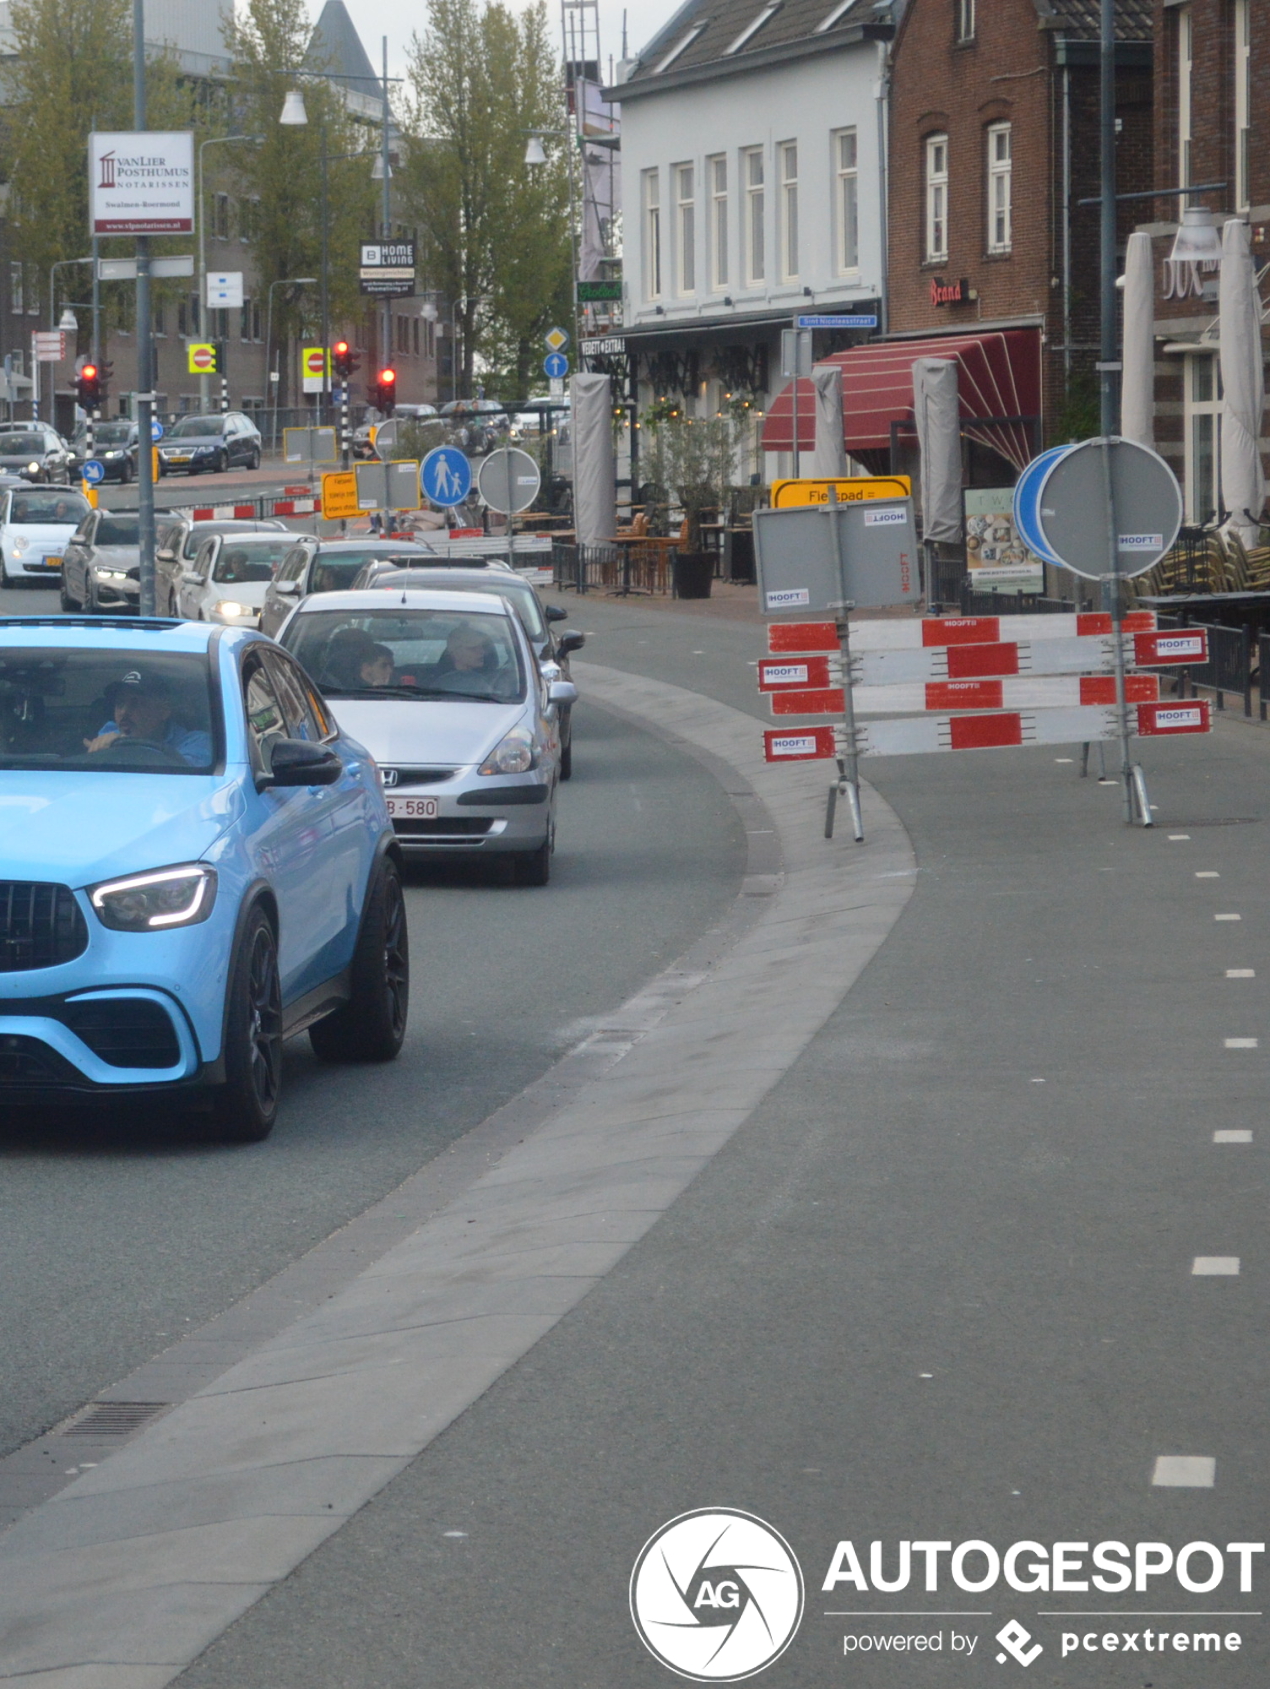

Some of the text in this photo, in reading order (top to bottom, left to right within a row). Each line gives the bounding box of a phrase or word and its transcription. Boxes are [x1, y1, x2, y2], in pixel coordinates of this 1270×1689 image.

[117, 167, 189, 177] POSTHUMUS
[382, 245, 413, 255] HOME
[382, 256, 414, 265] LIVING
[930, 279, 962, 306] Brand
[873, 514, 904, 522] HOOFT
[1121, 536, 1154, 544] HOOFT
[770, 592, 801, 602] HOOFT
[1159, 640, 1191, 648] HOOFT
[767, 668, 799, 676] HOOFT
[1159, 712, 1191, 720] HOOFT
[775, 739, 807, 748] HOOFT
